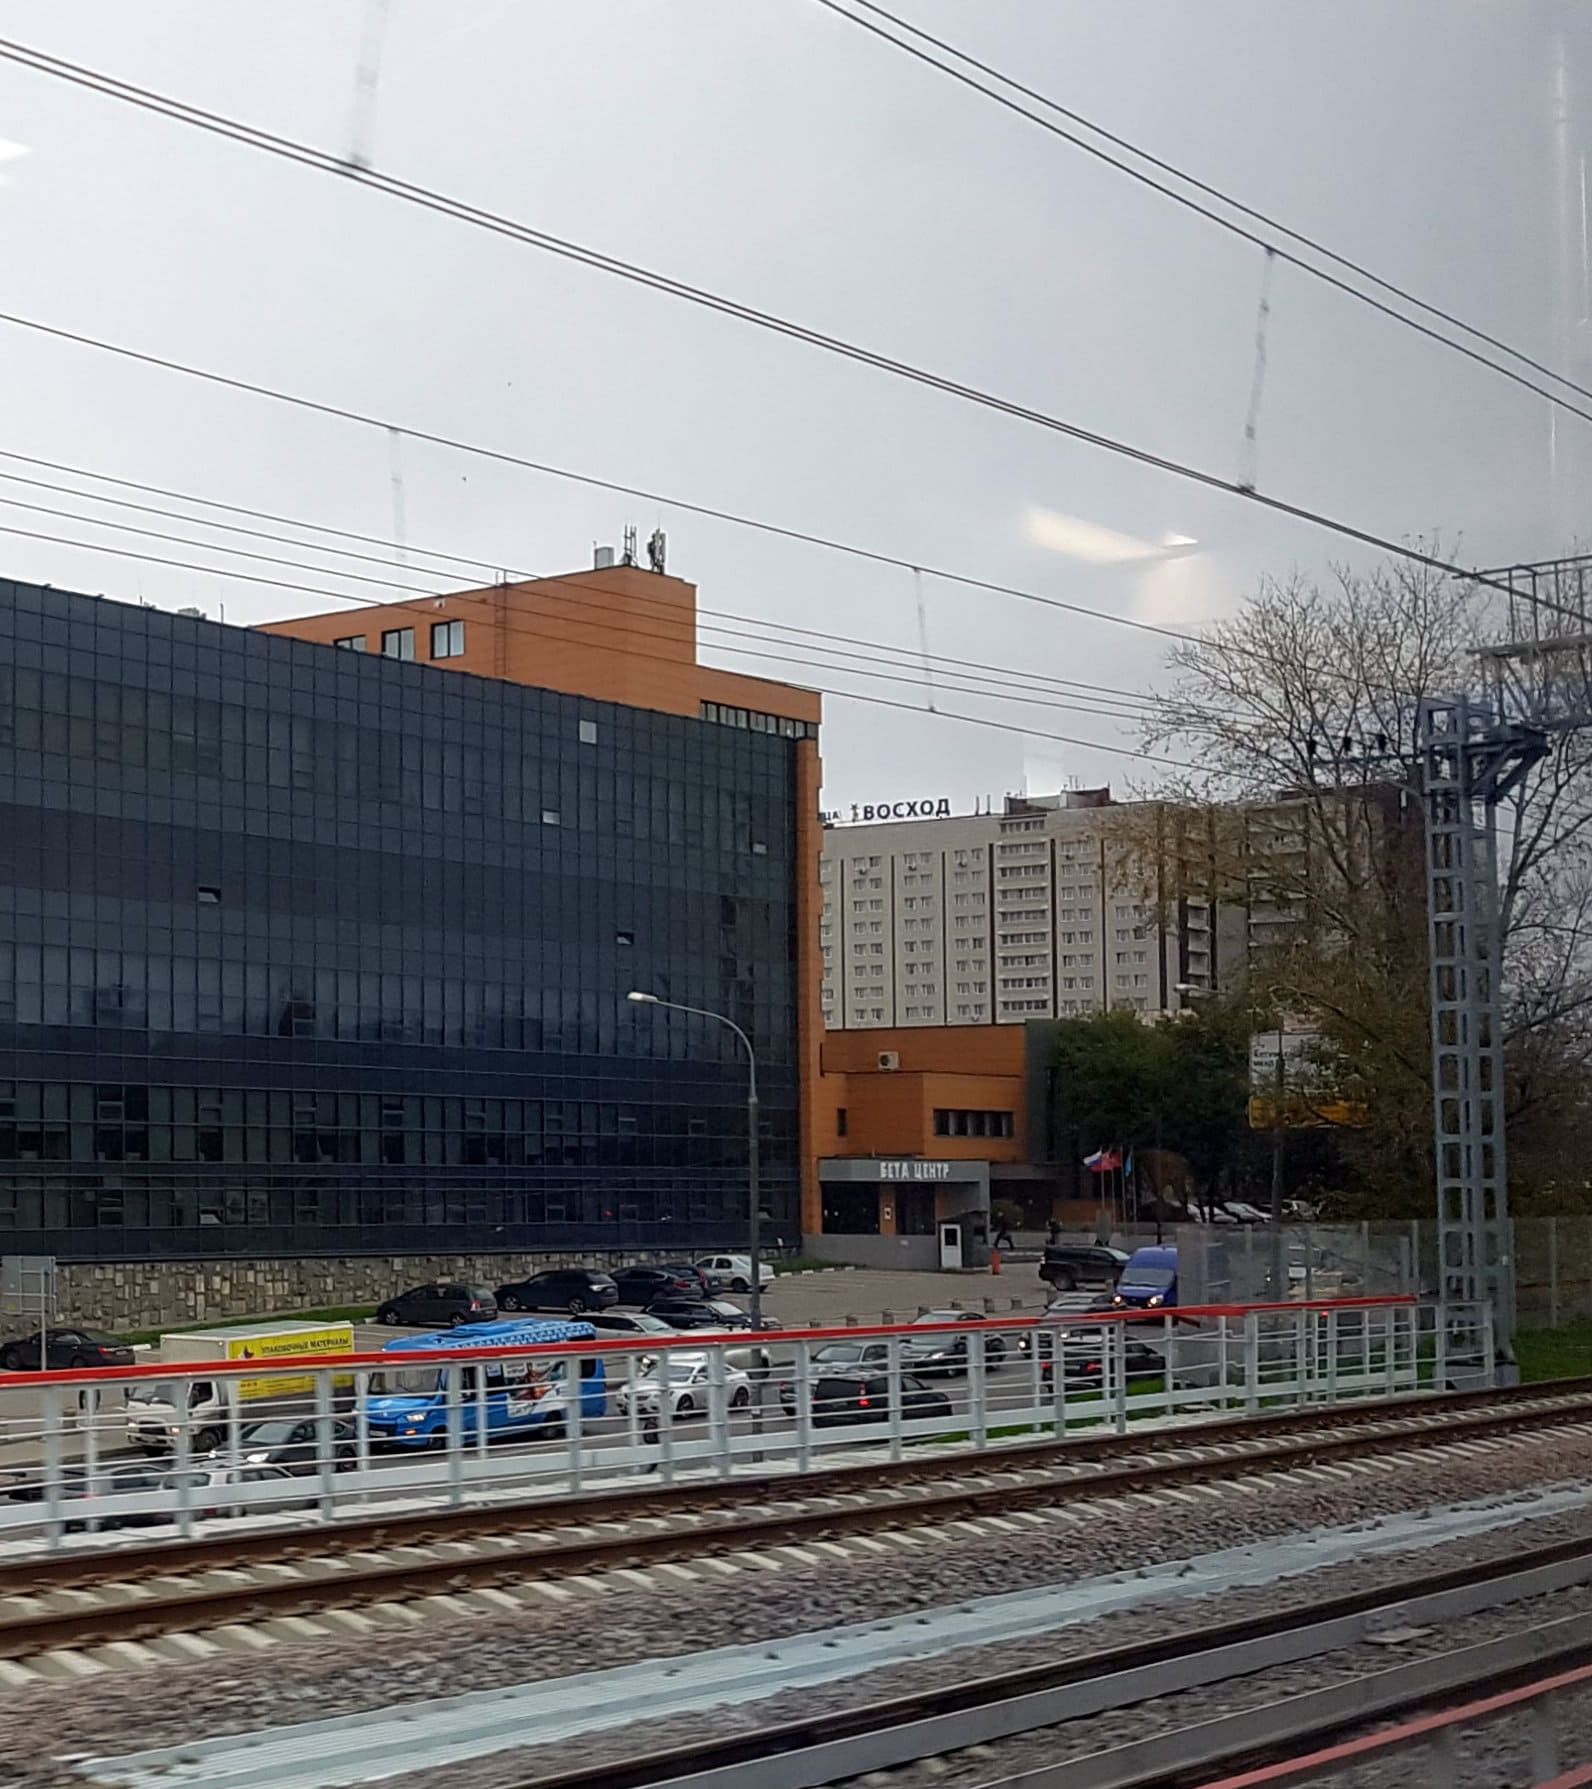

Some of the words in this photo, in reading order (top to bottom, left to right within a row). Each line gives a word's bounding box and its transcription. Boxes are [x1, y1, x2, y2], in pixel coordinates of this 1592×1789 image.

[863, 798, 951, 821] ВОСХОД
[880, 1161, 909, 1178] БЕТА
[914, 1162, 950, 1180] ЦЕНТР
[310, 1336, 349, 1350] МАТЕРИАЛЫ
